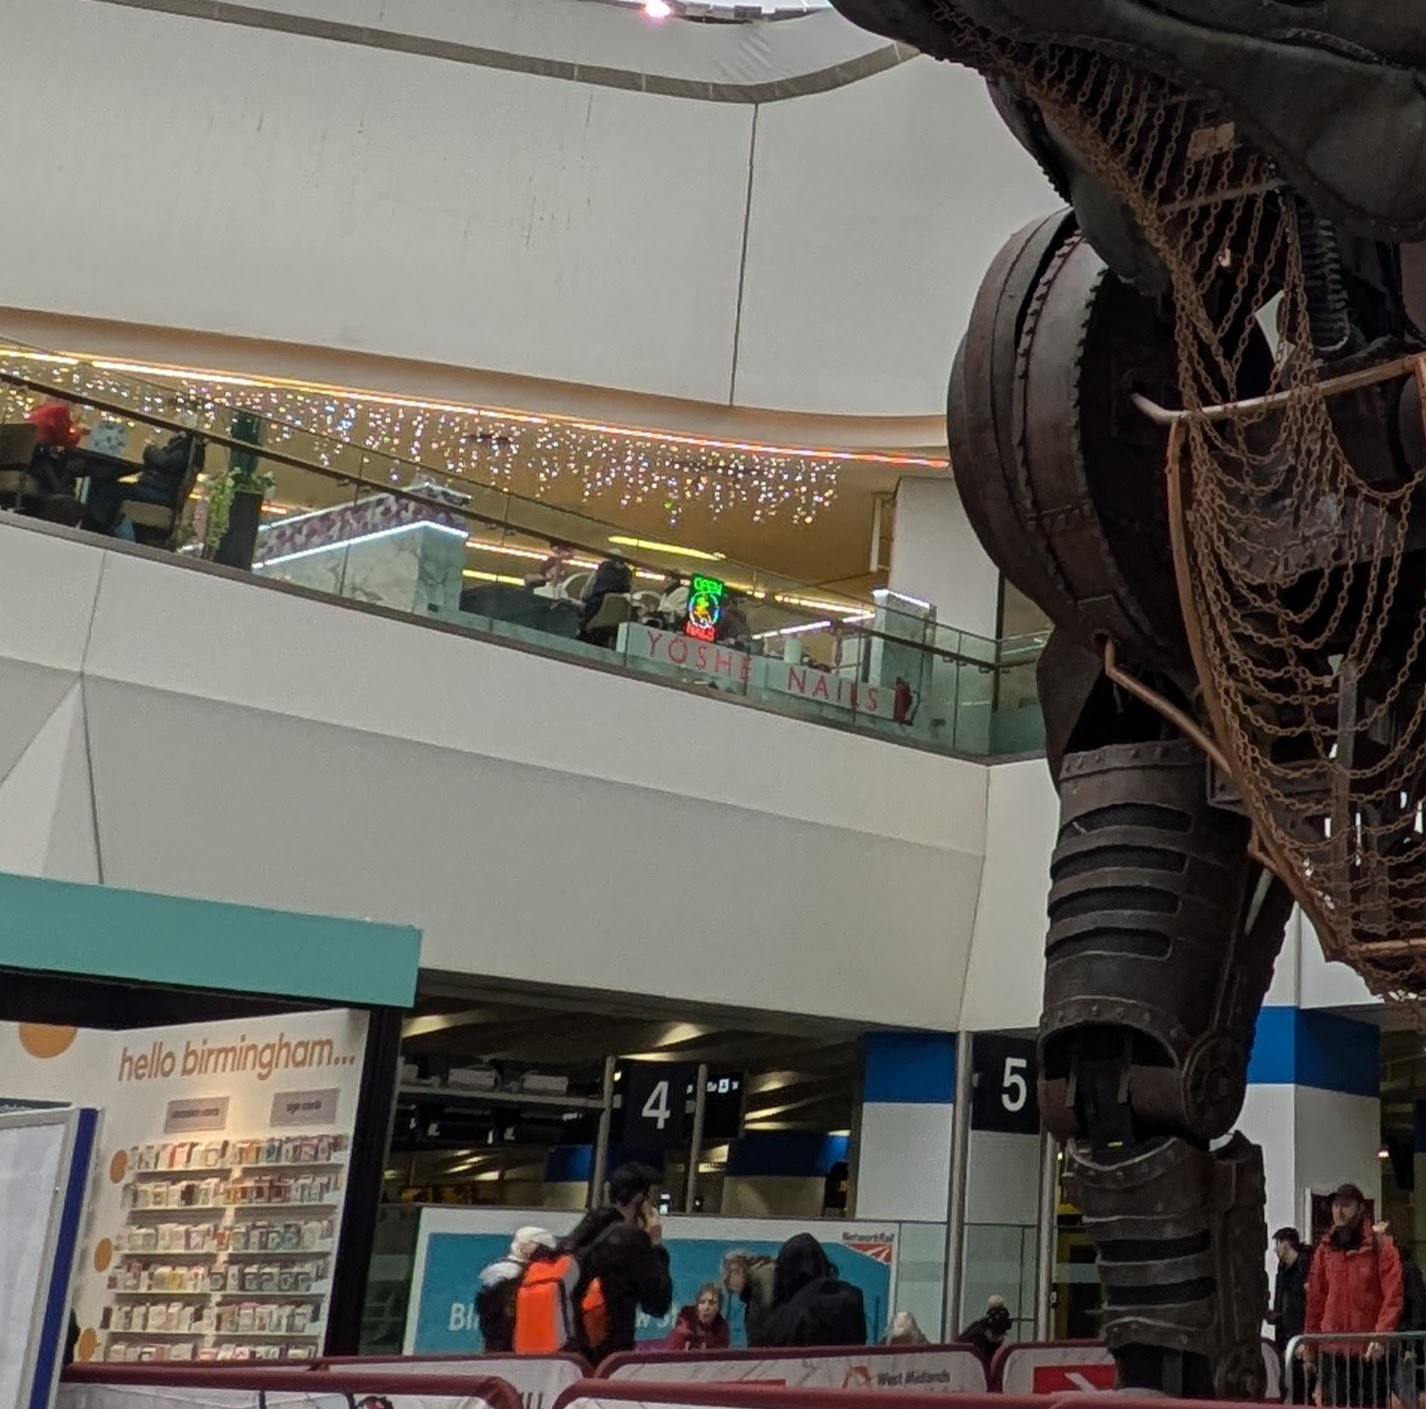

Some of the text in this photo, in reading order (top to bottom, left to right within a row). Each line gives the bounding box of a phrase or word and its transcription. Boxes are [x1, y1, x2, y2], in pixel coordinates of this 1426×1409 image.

[787, 666, 878, 711] NAILS
[117, 1032, 356, 1082] hello birmingham...
[641, 1080, 671, 1130] 4
[1001, 1056, 1027, 1112] 5
